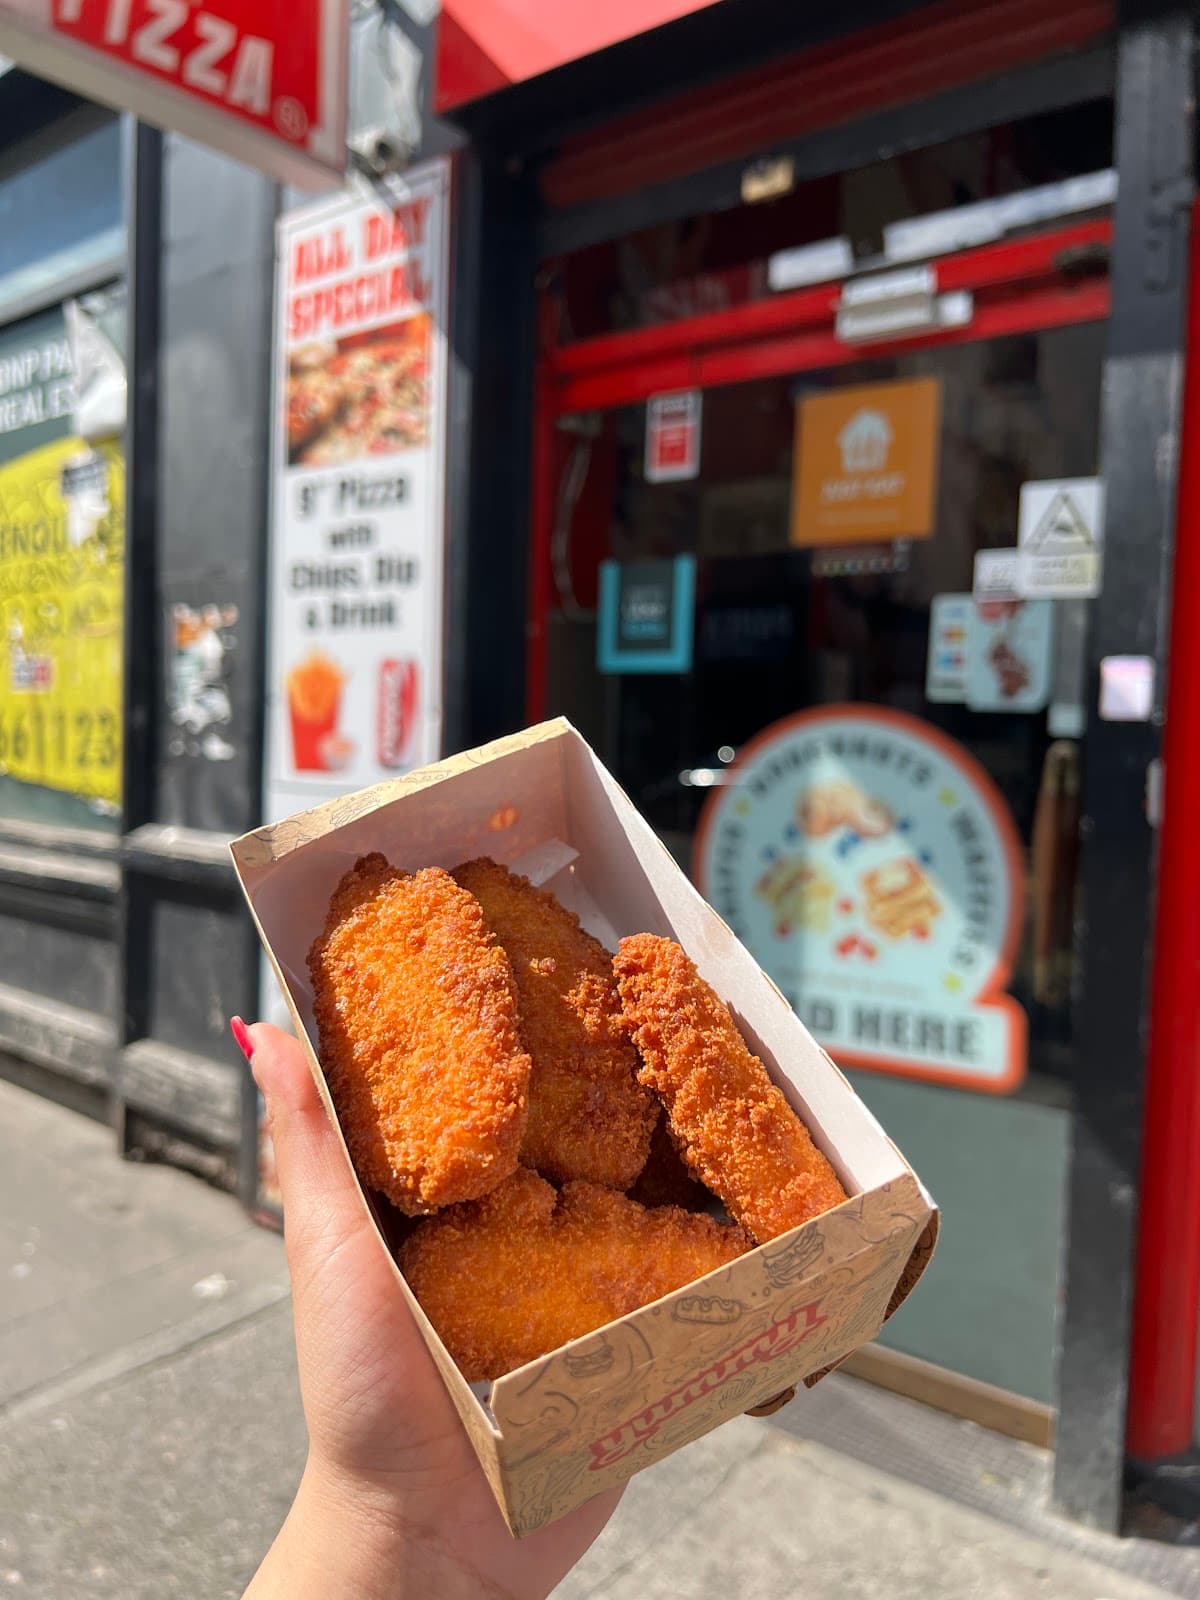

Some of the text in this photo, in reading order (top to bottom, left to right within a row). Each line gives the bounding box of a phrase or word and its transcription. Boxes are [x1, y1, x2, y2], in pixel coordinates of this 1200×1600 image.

[293, 196, 432, 284] ALL DAY
[291, 258, 432, 341] SPECIAL
[335, 474, 408, 513] Pizza
[330, 600, 396, 628] Drink
[852, 1004, 979, 1062] HERE
[590, 1303, 828, 1471] yummy
